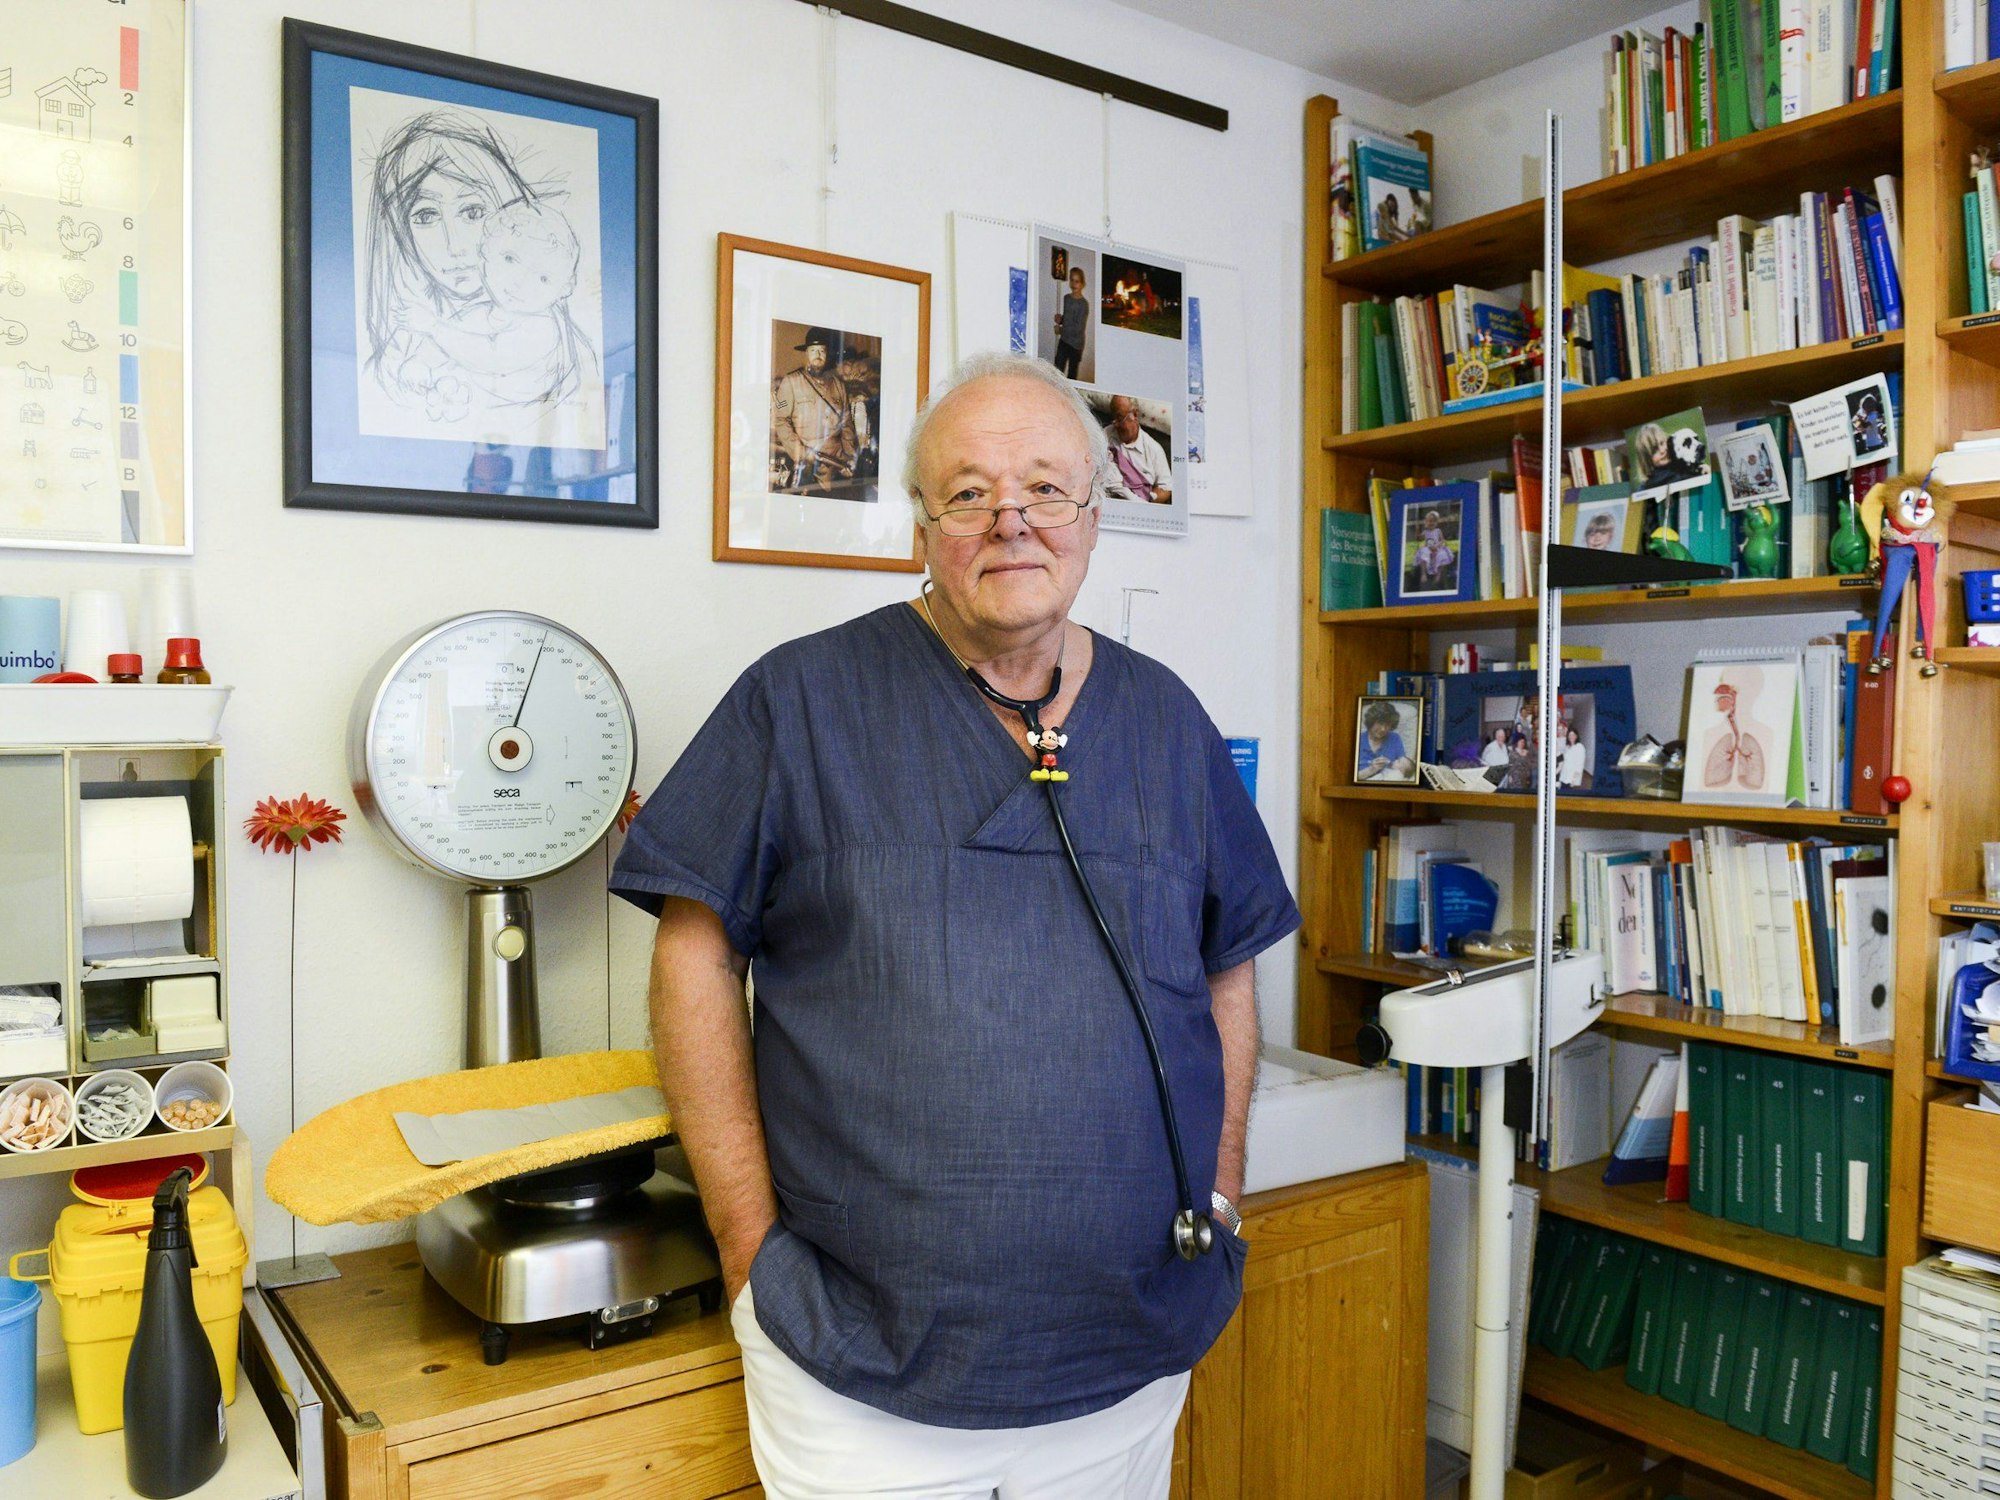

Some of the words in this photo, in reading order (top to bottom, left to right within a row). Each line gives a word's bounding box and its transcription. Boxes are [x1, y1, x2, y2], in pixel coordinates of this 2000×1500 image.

[124, 93, 134, 106] 2
[122, 135, 134, 148] 4
[123, 218, 134, 231] 6
[122, 256, 134, 268] 8
[119, 334, 137, 347] 10
[120, 407, 137, 419] 12
[124, 469, 135, 481] B
[516, 666, 525, 674] kg
[493, 788, 520, 798] seca
[1854, 1095, 1866, 1104] 47
[1775, 1167, 1783, 1213] pädiatrische
[1752, 1347, 1760, 1370] praxis
[1823, 1393, 1836, 1439] pädiatrische
[1831, 1370, 1839, 1394] praxis
[1865, 1386, 1873, 1411] praxis
